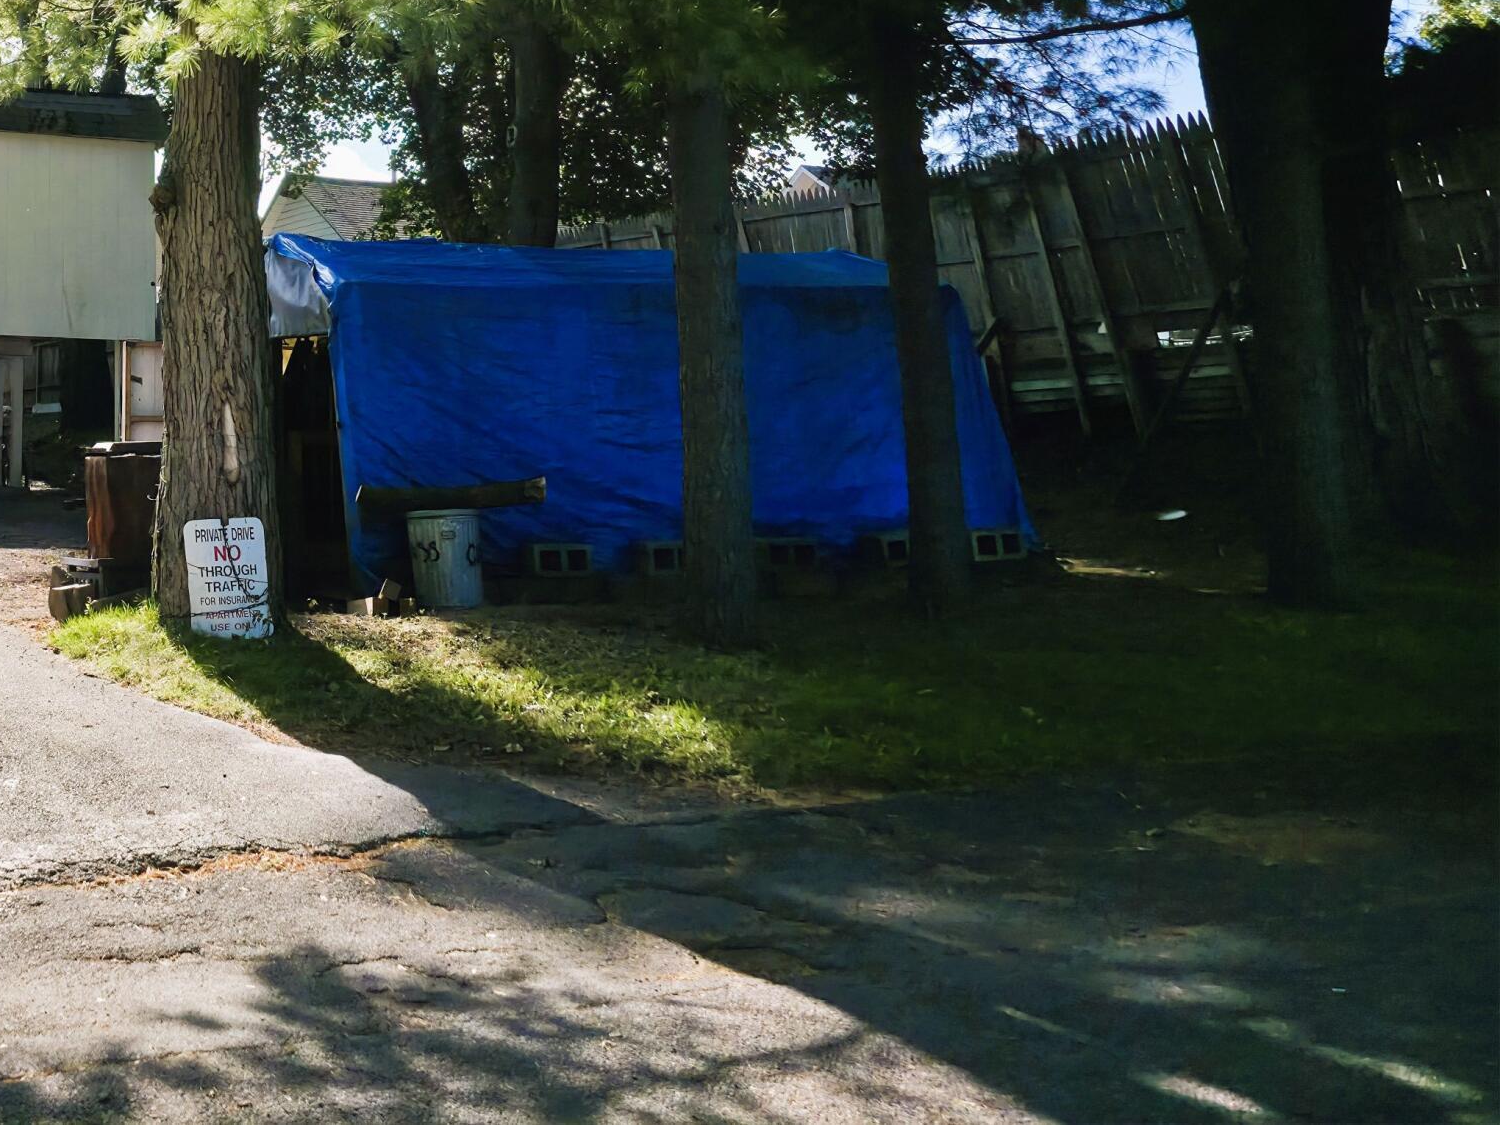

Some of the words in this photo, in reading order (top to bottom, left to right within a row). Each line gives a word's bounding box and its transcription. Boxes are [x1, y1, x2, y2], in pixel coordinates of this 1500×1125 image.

[195, 528, 229, 542] PRIVATE
[231, 527, 255, 541] DRIVE
[213, 544, 241, 562] NO
[199, 564, 257, 577] THROUGH
[204, 579, 256, 593] TRAFFIC
[200, 597, 216, 606] FOR
[210, 623, 230, 632] USE
